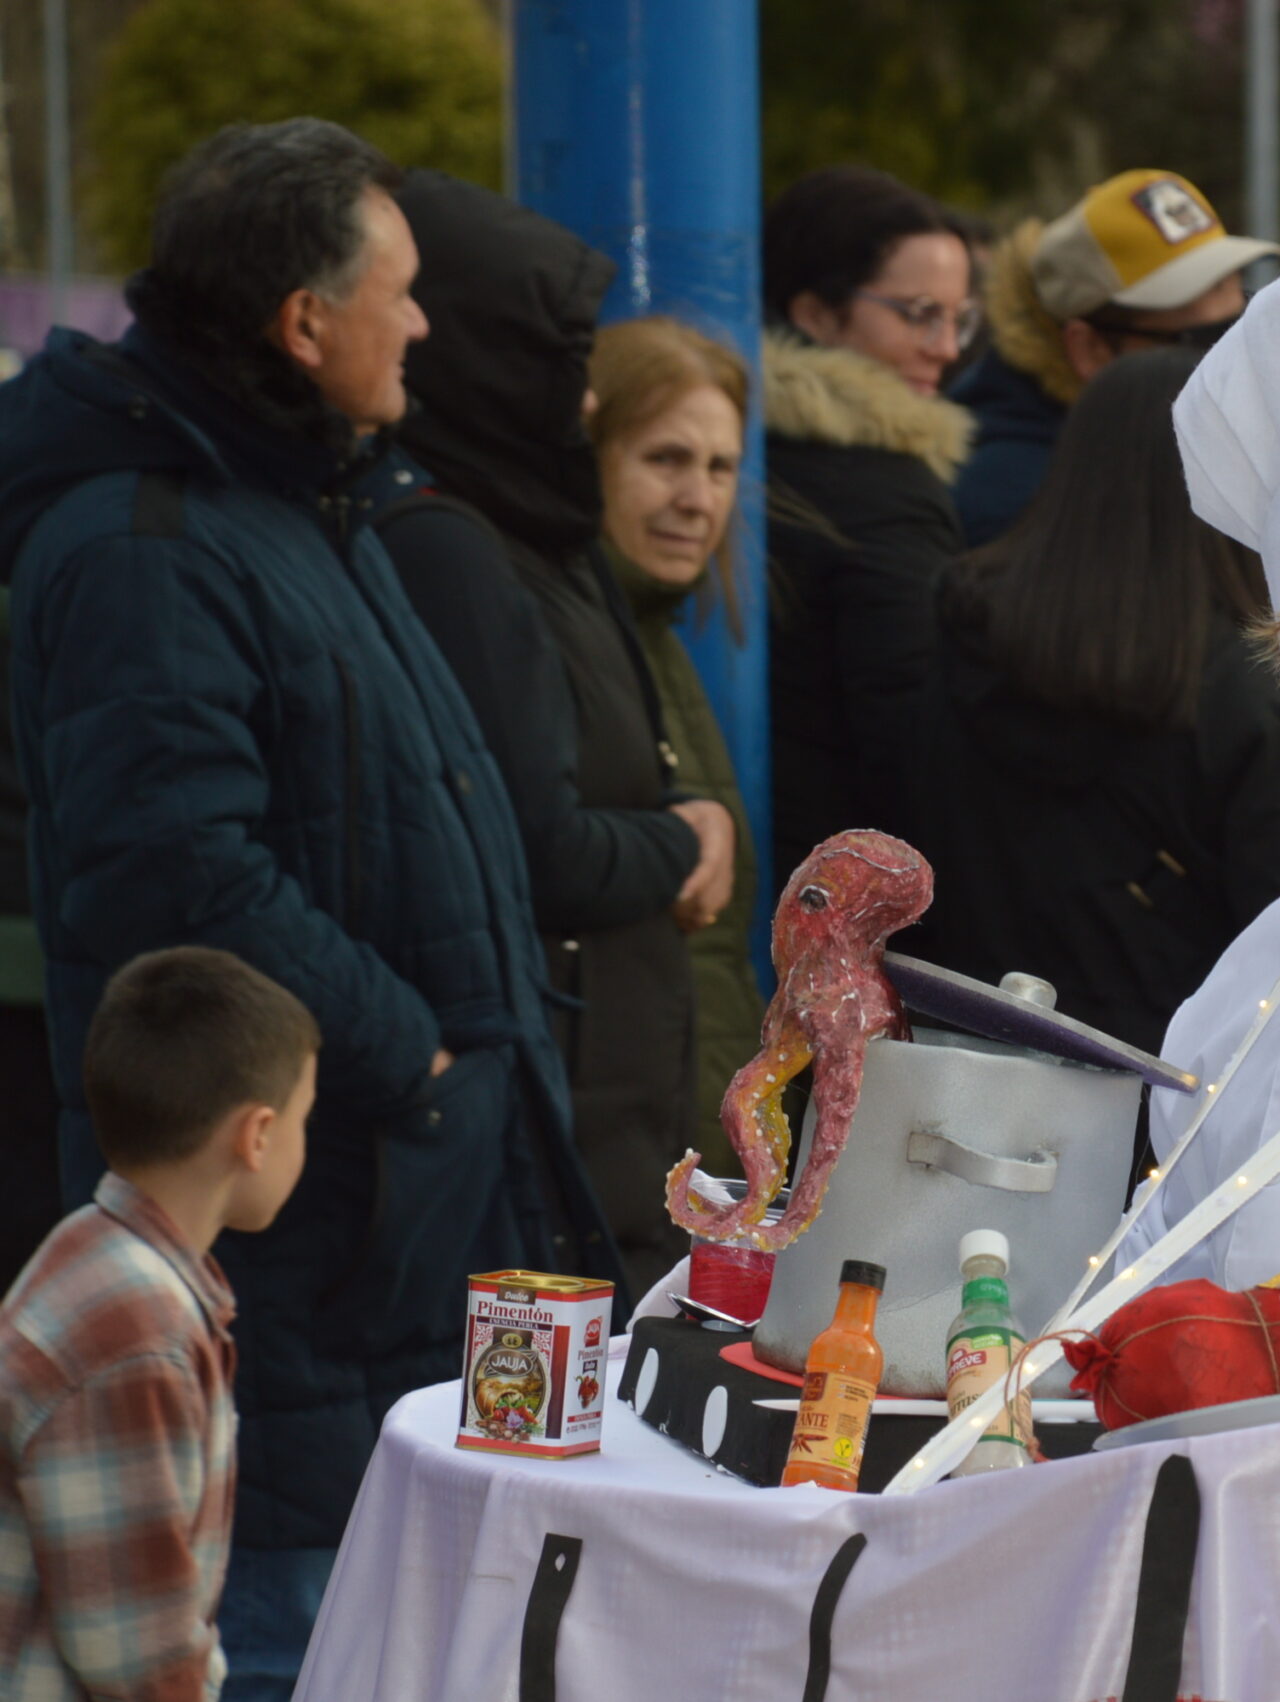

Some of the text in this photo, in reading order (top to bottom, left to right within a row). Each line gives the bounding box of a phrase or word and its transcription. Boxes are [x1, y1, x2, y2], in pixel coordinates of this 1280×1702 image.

[504, 1291, 529, 1302] Dulce
[477, 1300, 553, 1323] Pimentón
[491, 1355, 528, 1371] JAUJA
[797, 1412, 829, 1428] ANTE
